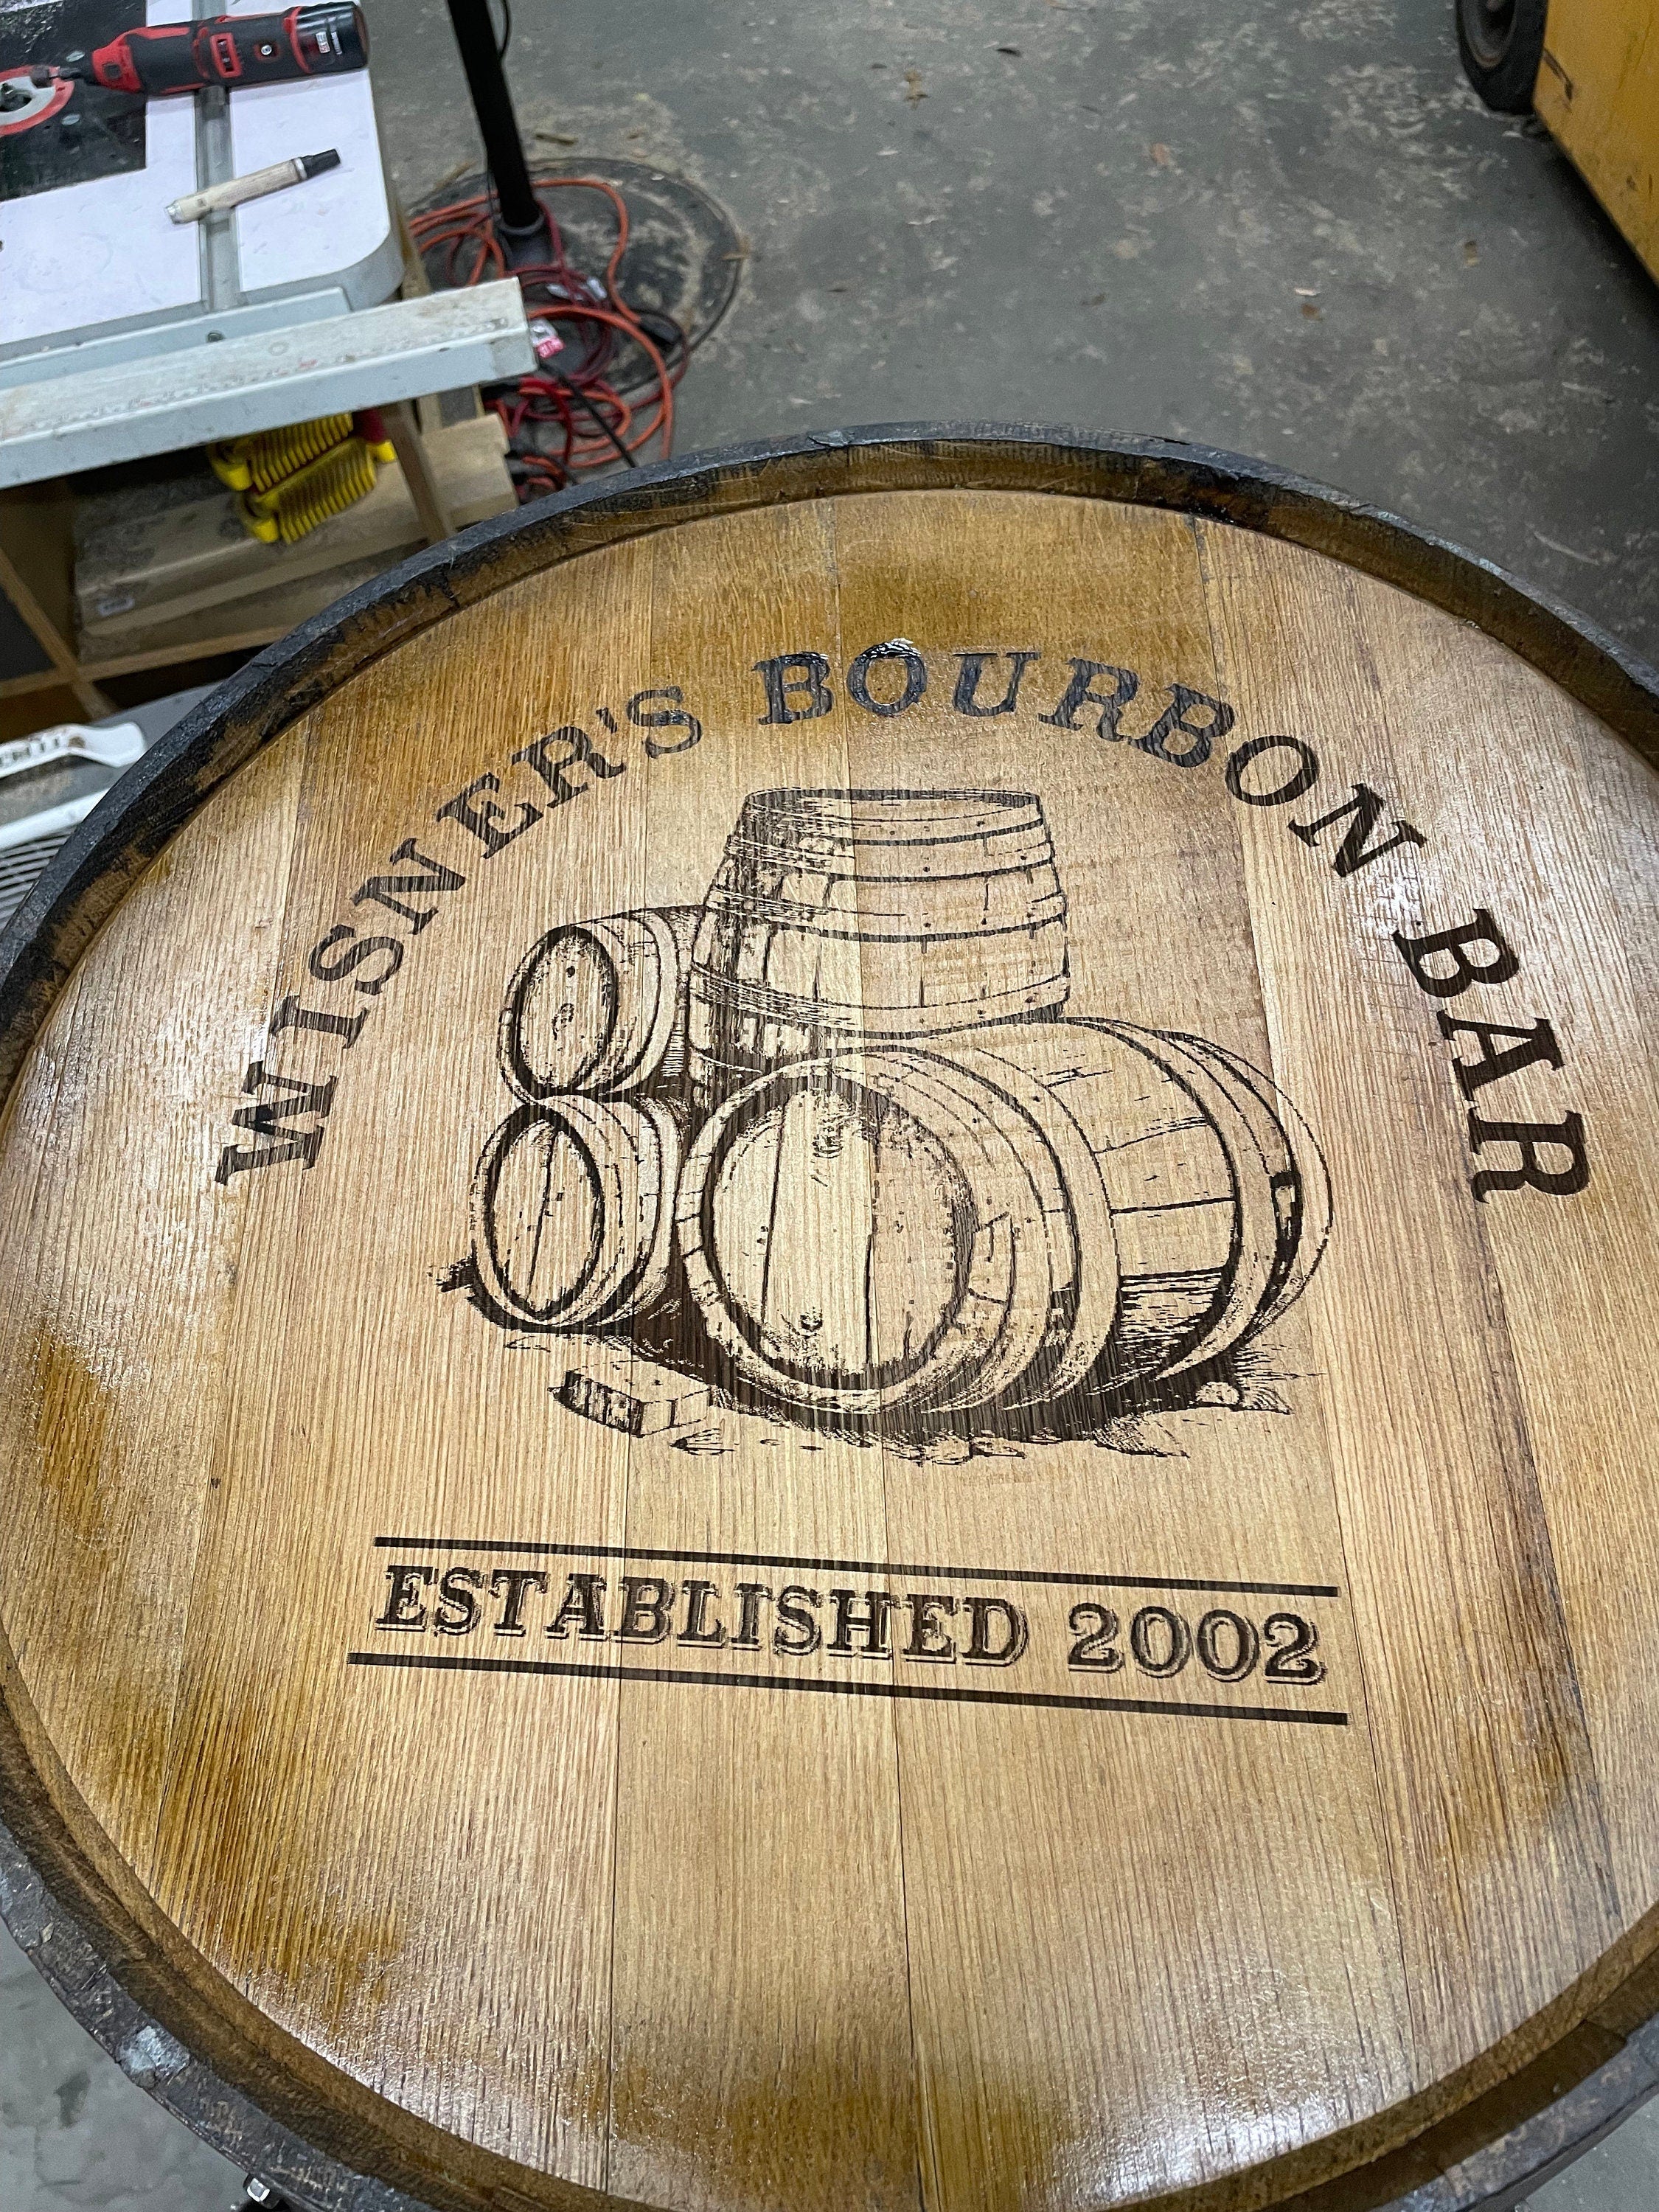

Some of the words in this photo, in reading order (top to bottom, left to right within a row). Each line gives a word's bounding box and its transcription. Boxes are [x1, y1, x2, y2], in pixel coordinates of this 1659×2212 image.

[215, 686, 705, 1186] WISNER'S
[752, 639, 1426, 878] BOURBON
[1392, 908, 1591, 1204] BAR
[373, 1565, 1028, 1666] ESTABLISHED
[1068, 1601, 1328, 1686] 2002
